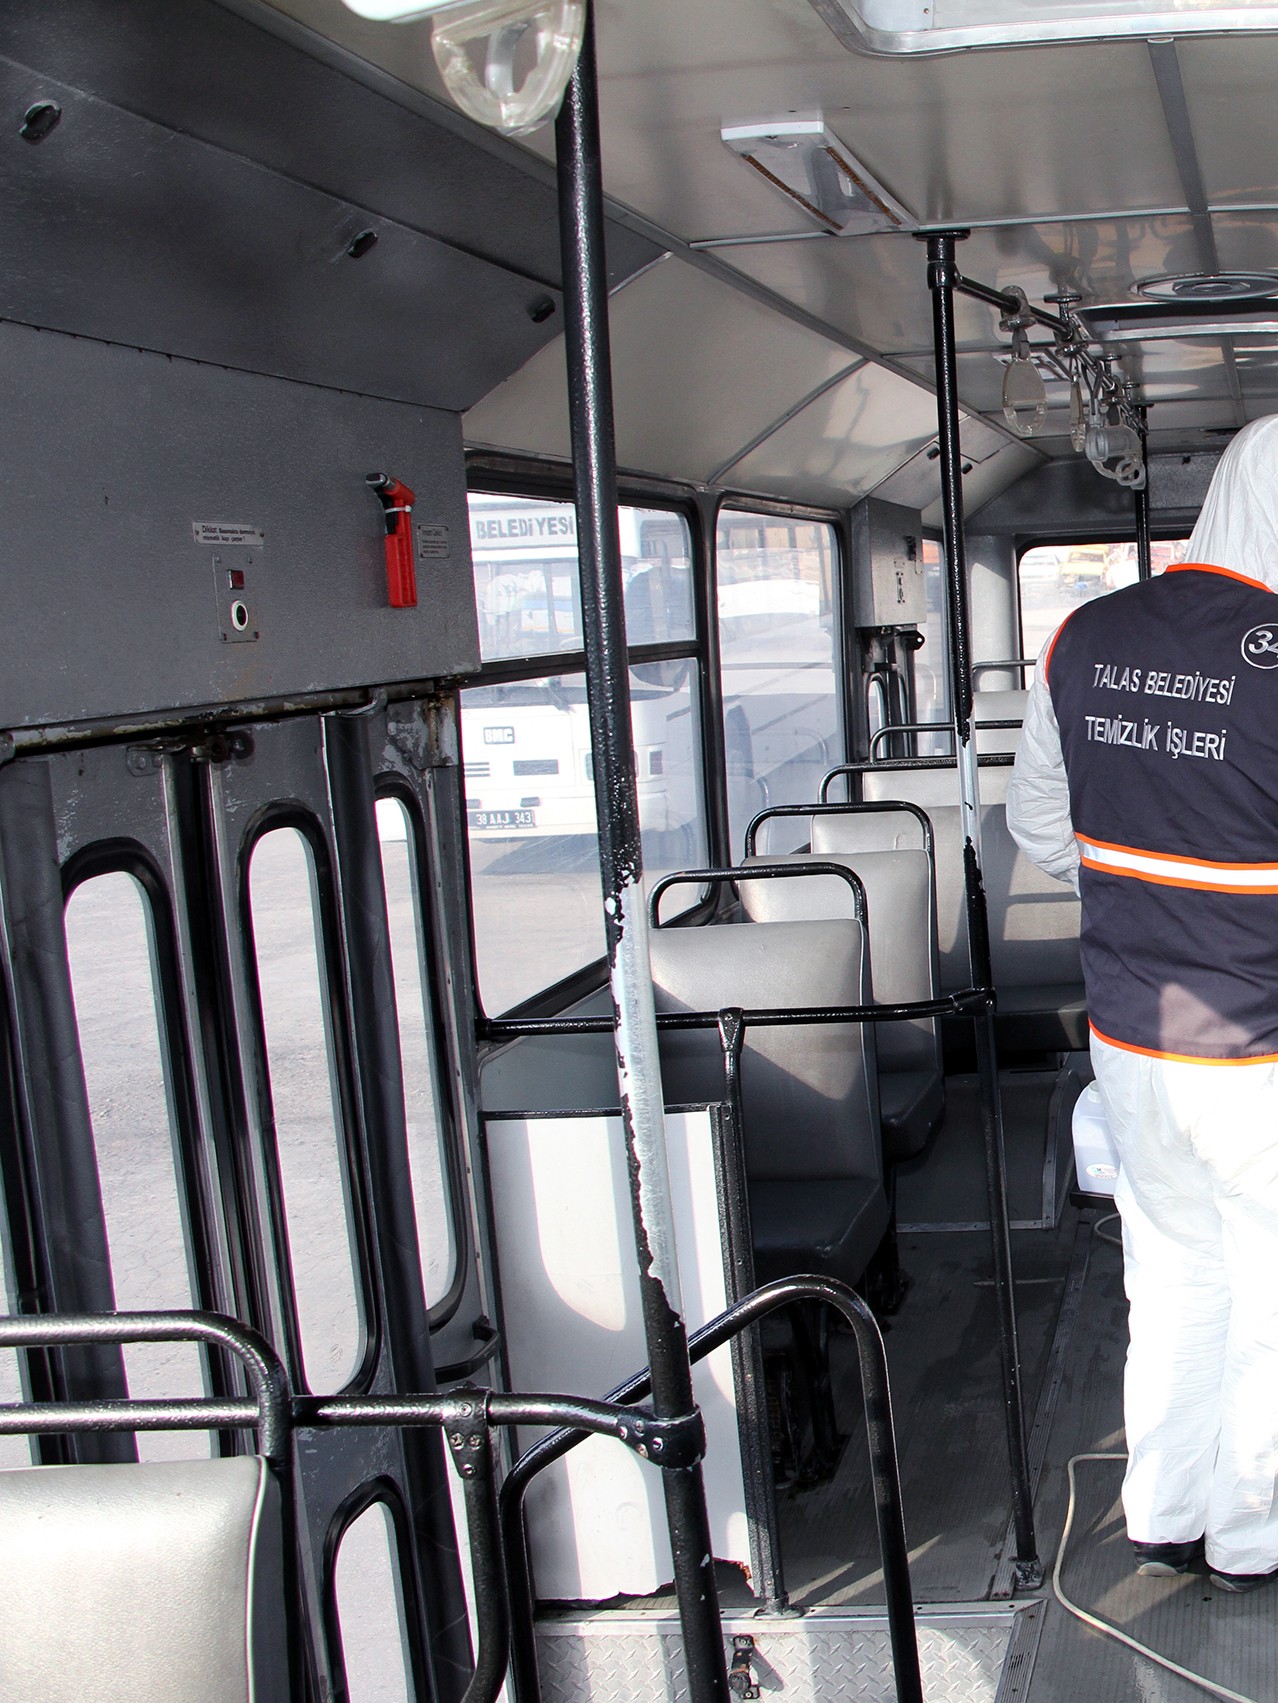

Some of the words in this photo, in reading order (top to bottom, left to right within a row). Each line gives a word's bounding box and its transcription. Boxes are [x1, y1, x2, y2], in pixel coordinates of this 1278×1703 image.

[1092, 664, 1141, 693] TALAS
[1144, 671, 1236, 705] BELEDİYESİ
[485, 728, 514, 743] BMC
[1085, 714, 1160, 751] TEMİZLİK
[1166, 721, 1227, 761] İŞLERİ
[489, 813, 509, 824] AAJ
[514, 811, 531, 823] 343
